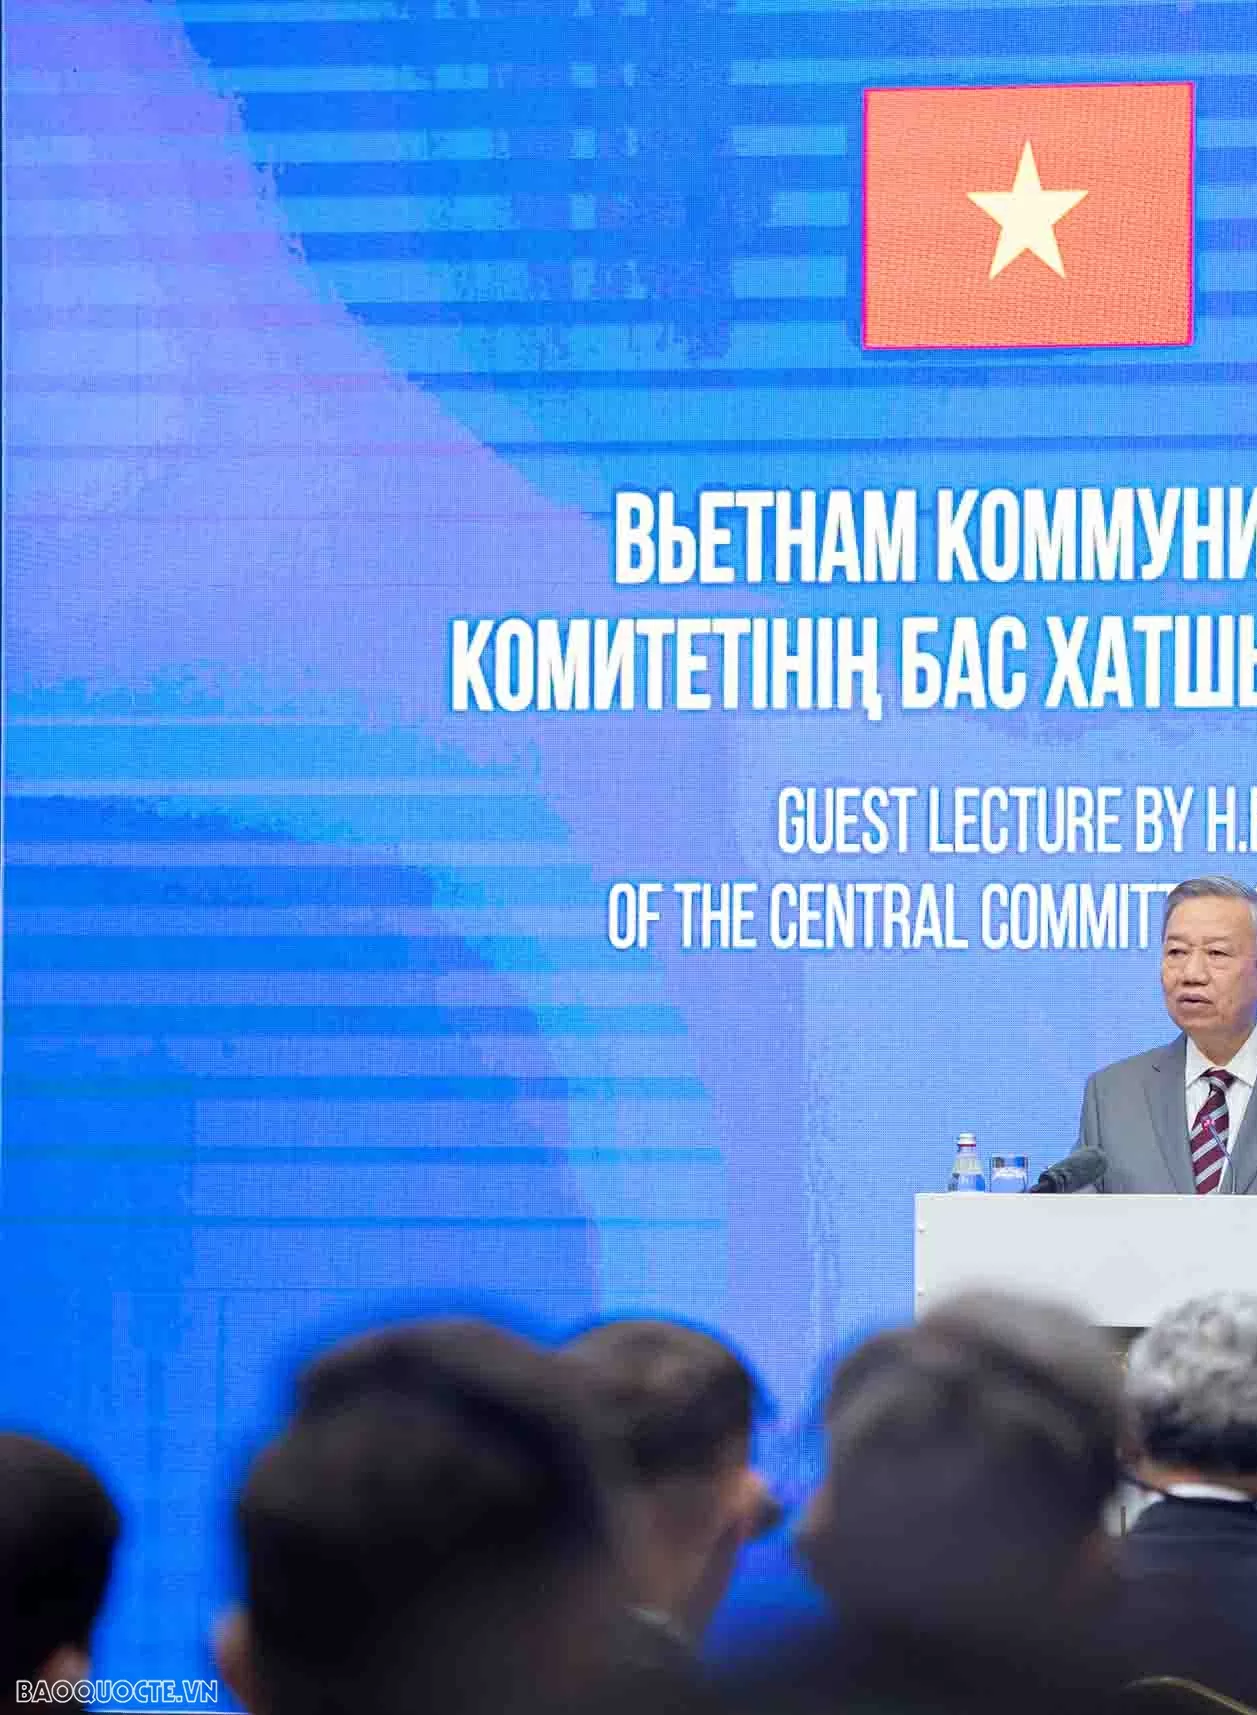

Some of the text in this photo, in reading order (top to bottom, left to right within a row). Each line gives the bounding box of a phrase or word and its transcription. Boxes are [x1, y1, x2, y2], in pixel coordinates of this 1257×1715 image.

[616, 490, 916, 583] ВЬЕТНАМ
[453, 617, 882, 721] КОМИТЕТІНІҢ
[902, 617, 1026, 709] БАС
[778, 787, 917, 854] GUEST
[929, 787, 1121, 854] LECTURE
[1136, 787, 1193, 852] BY
[609, 883, 663, 949] OF
[674, 883, 757, 947] THE
[771, 883, 969, 948] CENTRAL
[982, 883, 1179, 950] COMMIT
